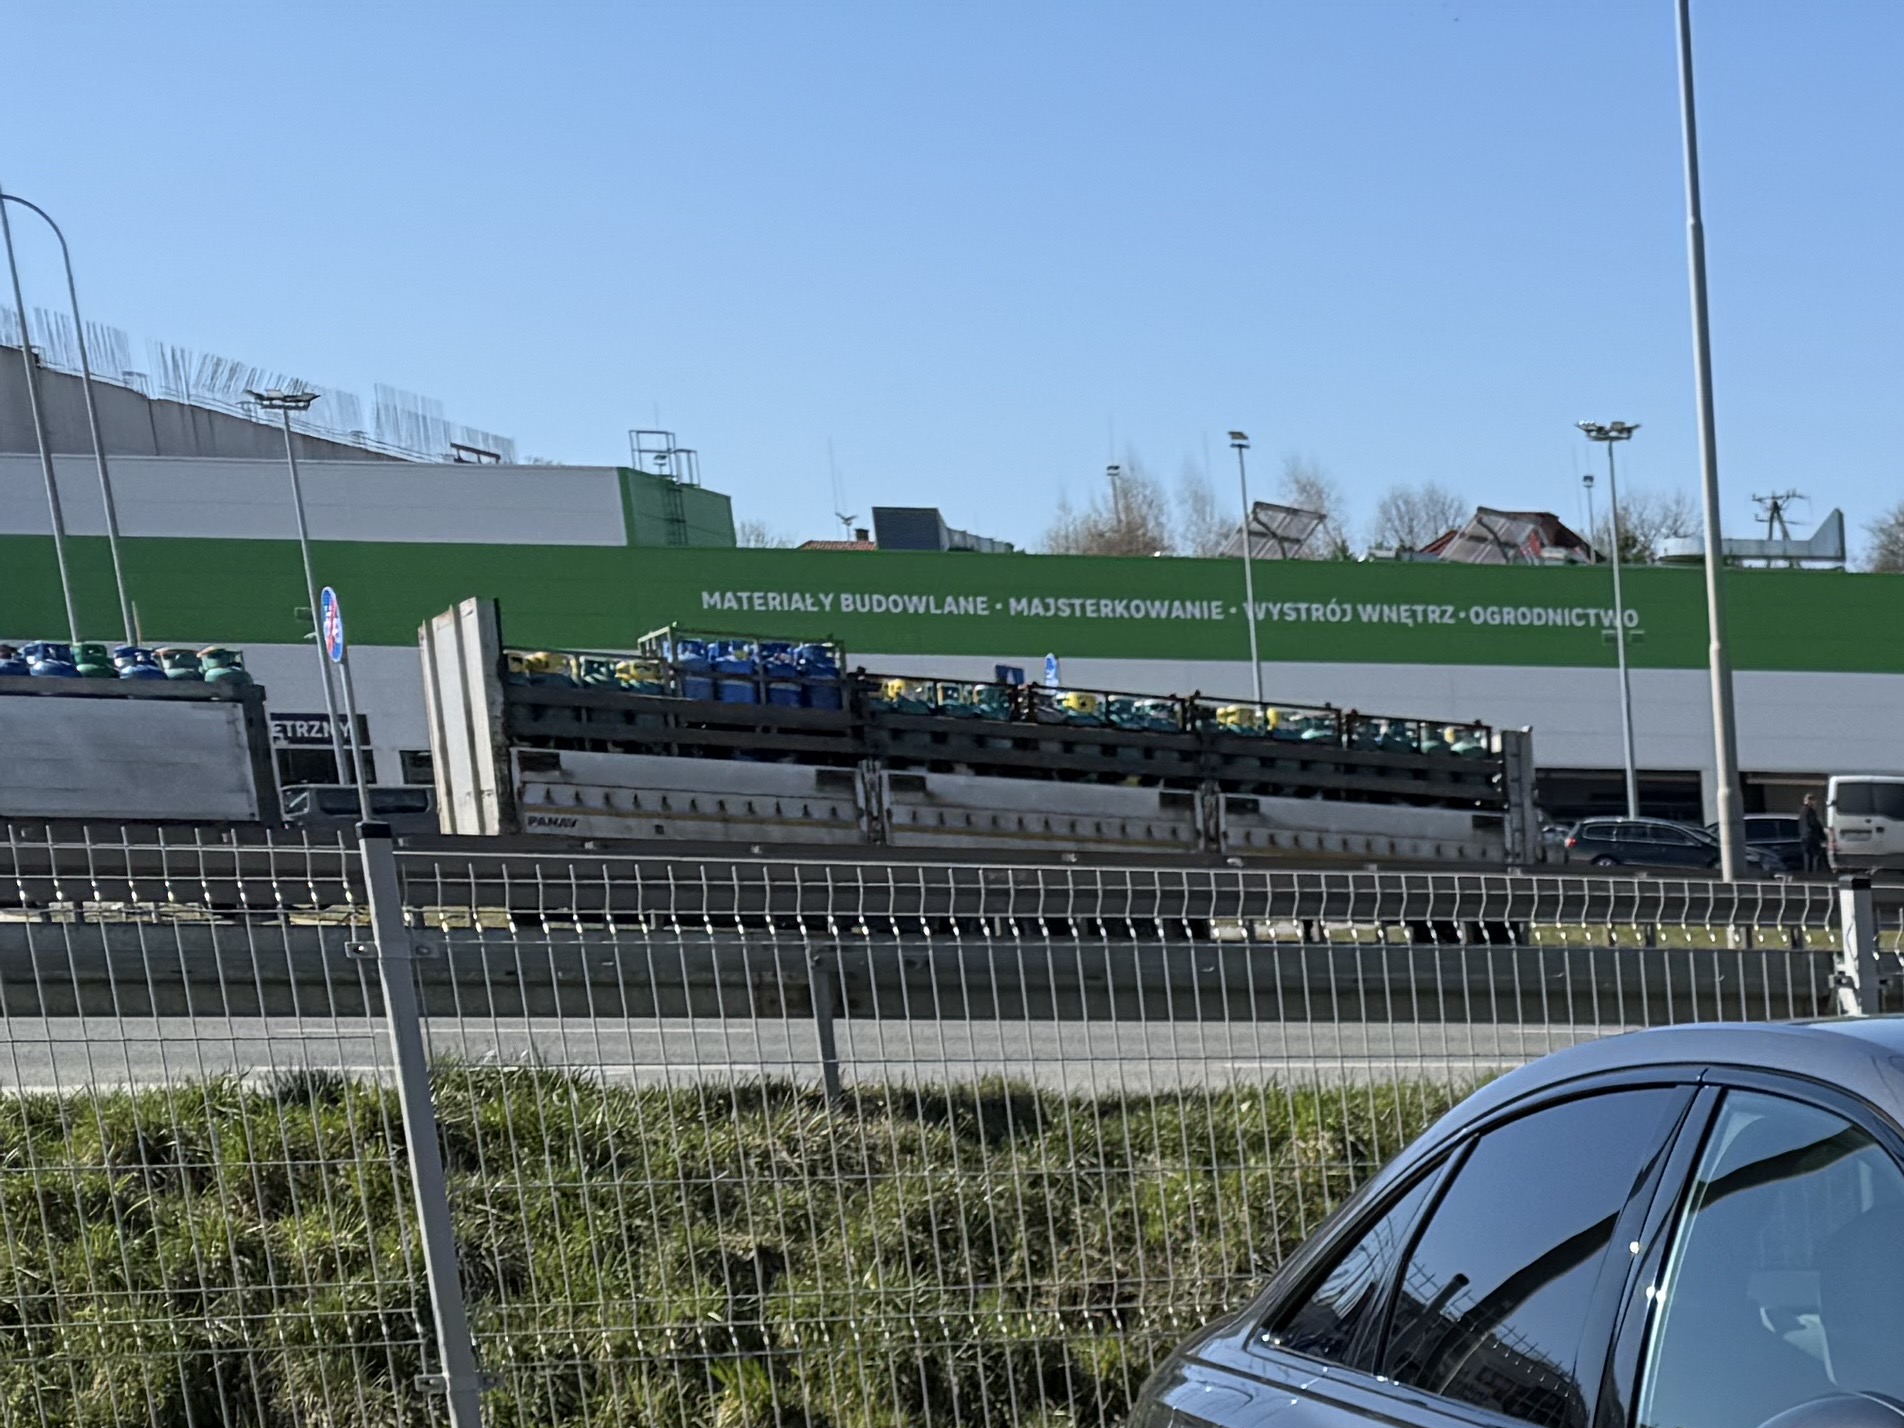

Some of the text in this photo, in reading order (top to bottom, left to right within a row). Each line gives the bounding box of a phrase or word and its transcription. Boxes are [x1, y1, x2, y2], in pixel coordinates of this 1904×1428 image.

[701, 591, 1639, 629] MATERIAŁY BUDOWLANE MAJSTERKOWANIE WYSTRÓJ WNĘTRZ OGRODNICTWO
